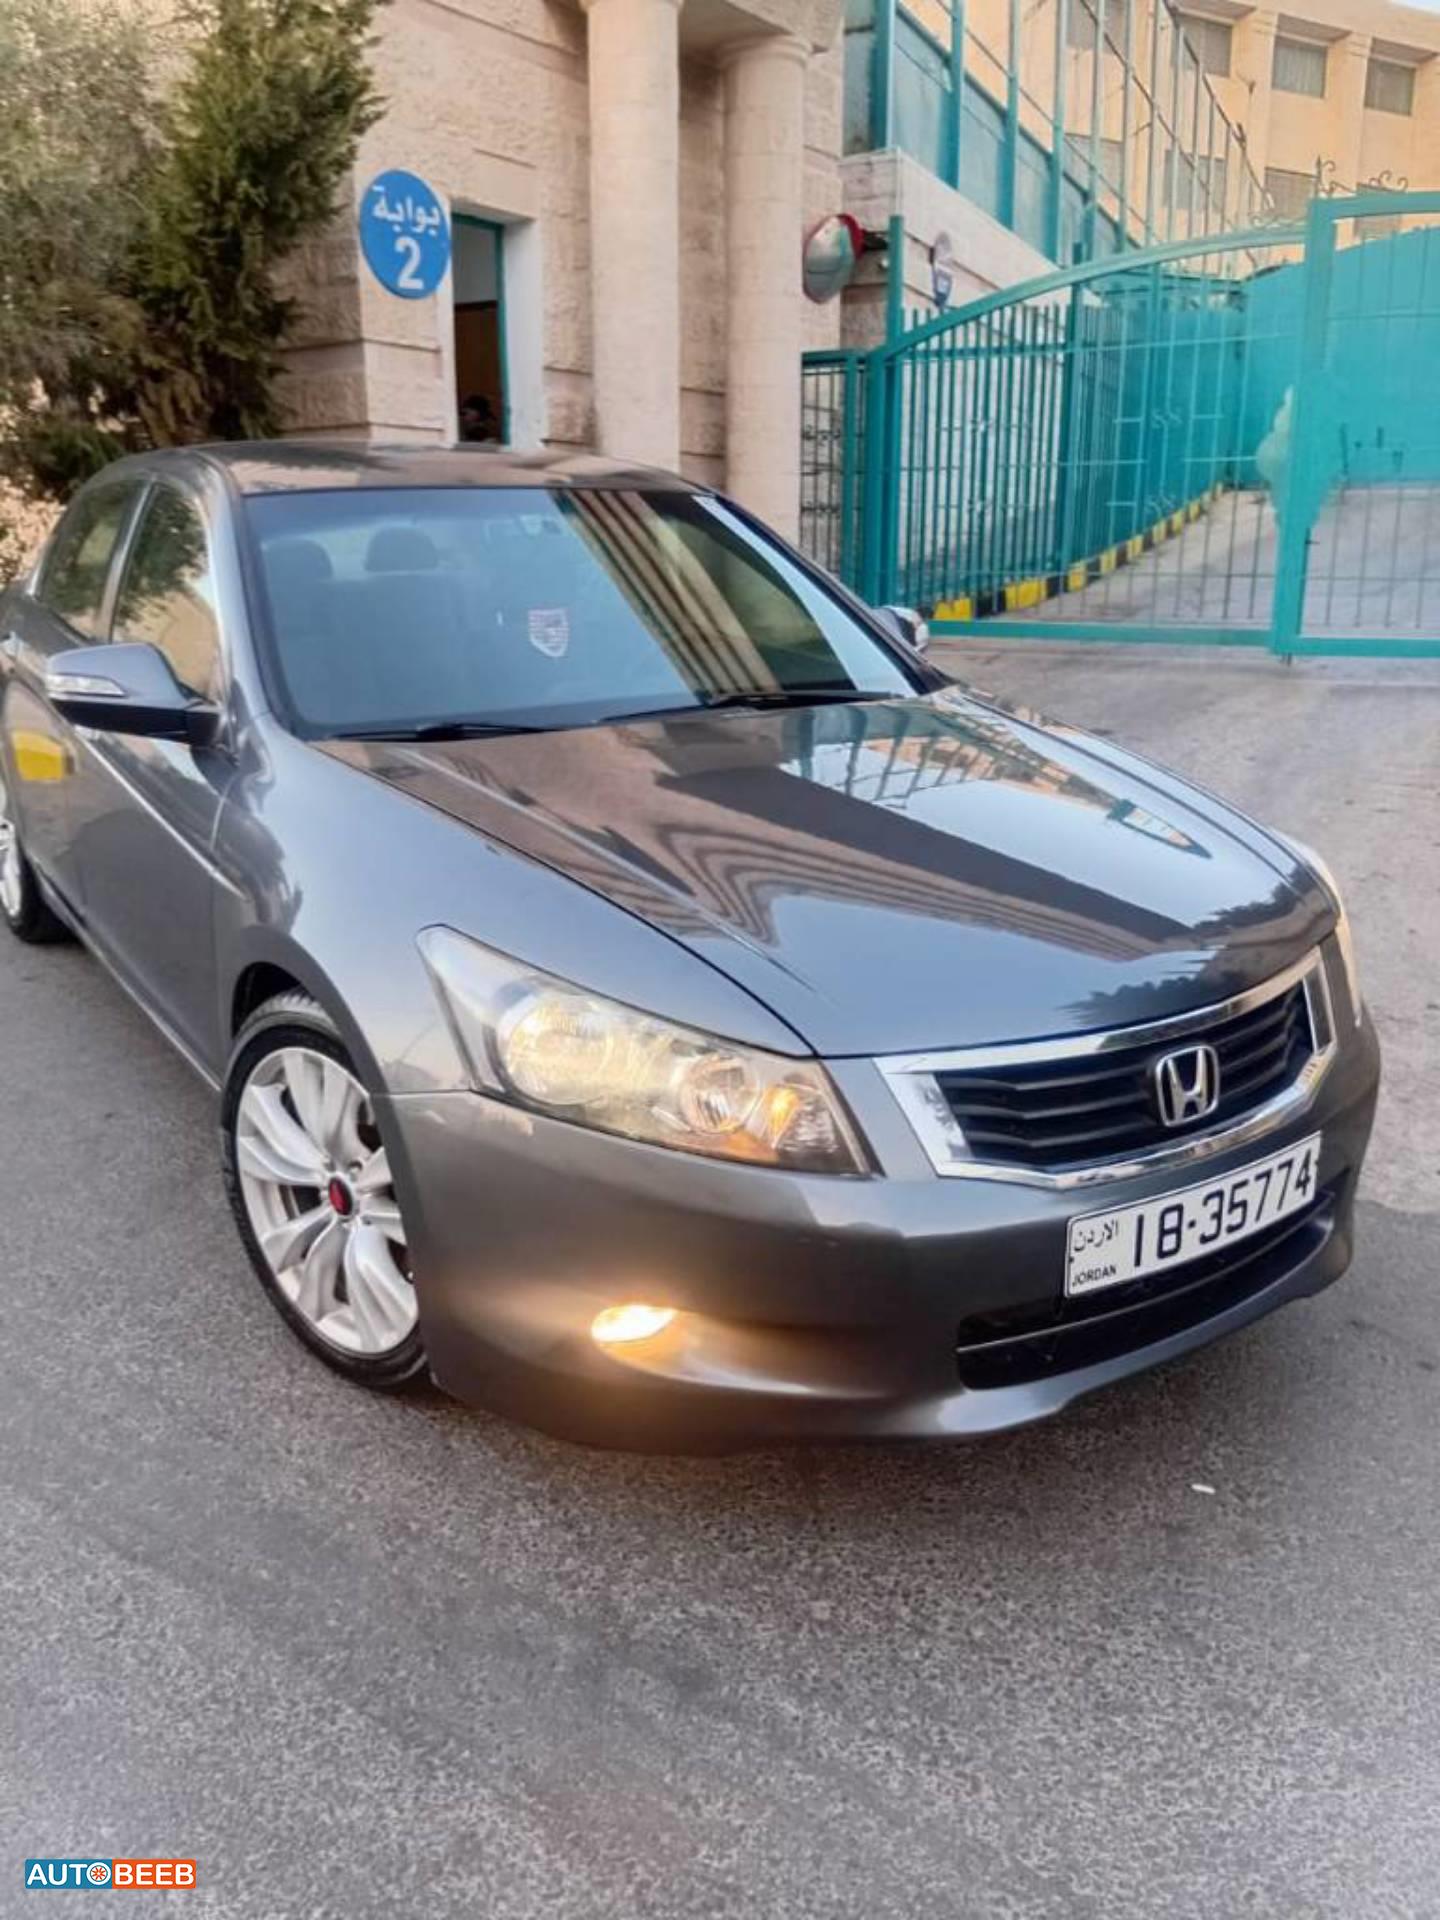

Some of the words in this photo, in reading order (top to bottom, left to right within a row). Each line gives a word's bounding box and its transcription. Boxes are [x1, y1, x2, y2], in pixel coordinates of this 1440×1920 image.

[372, 185, 441, 236] بوابة
[394, 236, 424, 290] 2
[1133, 1147, 1313, 1268] 18-35774
[1072, 1264, 1117, 1287] JORDAN
